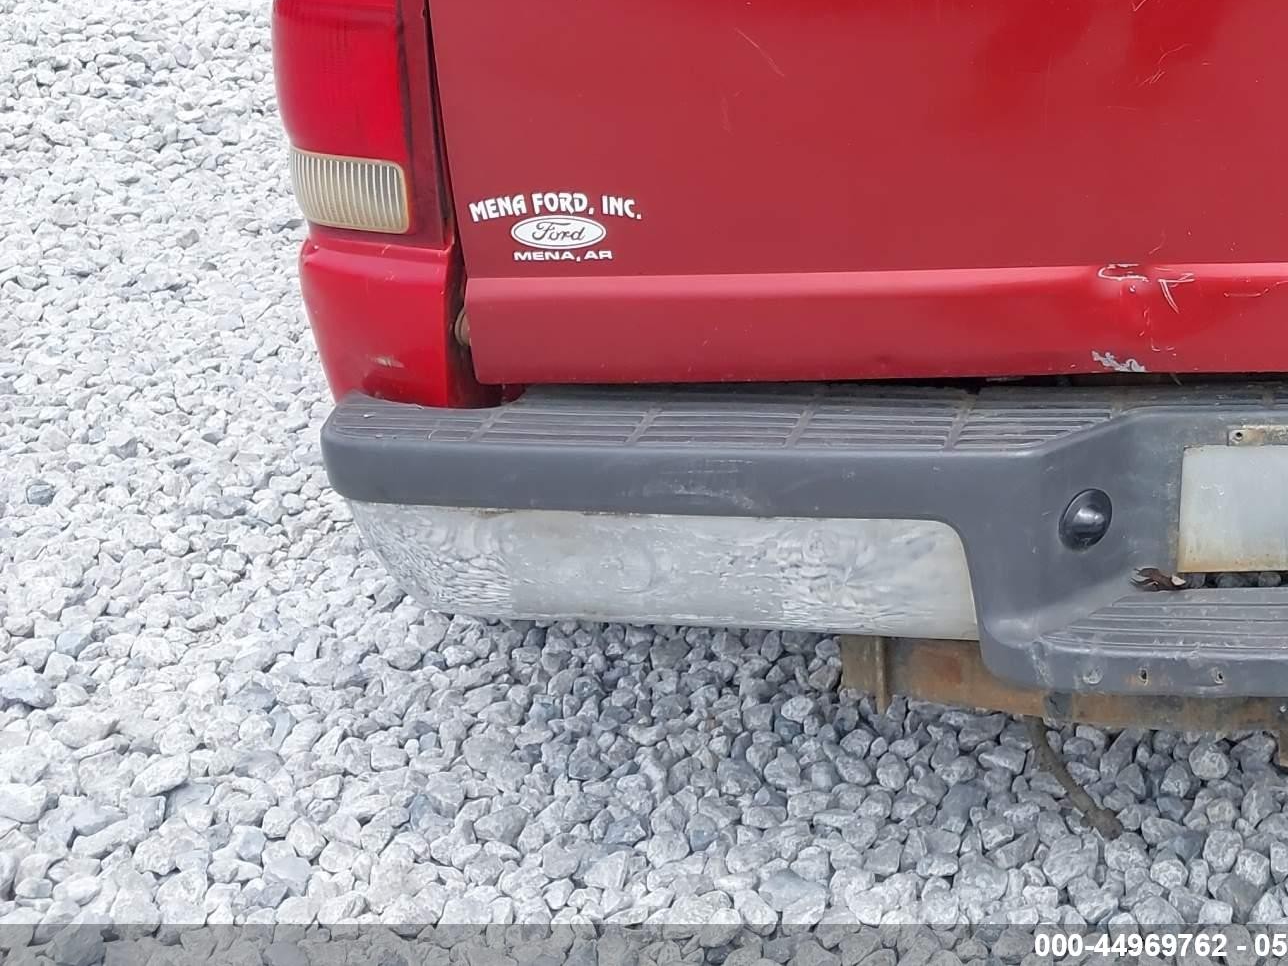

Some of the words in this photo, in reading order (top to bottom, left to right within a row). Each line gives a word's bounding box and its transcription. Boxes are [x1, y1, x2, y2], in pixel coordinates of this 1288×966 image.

[469, 194, 527, 222] MENA
[531, 192, 595, 215] FORD,
[602, 195, 643, 220] INC.
[531, 221, 586, 242] Ford
[513, 251, 581, 262] MENA,
[584, 250, 613, 260] AR
